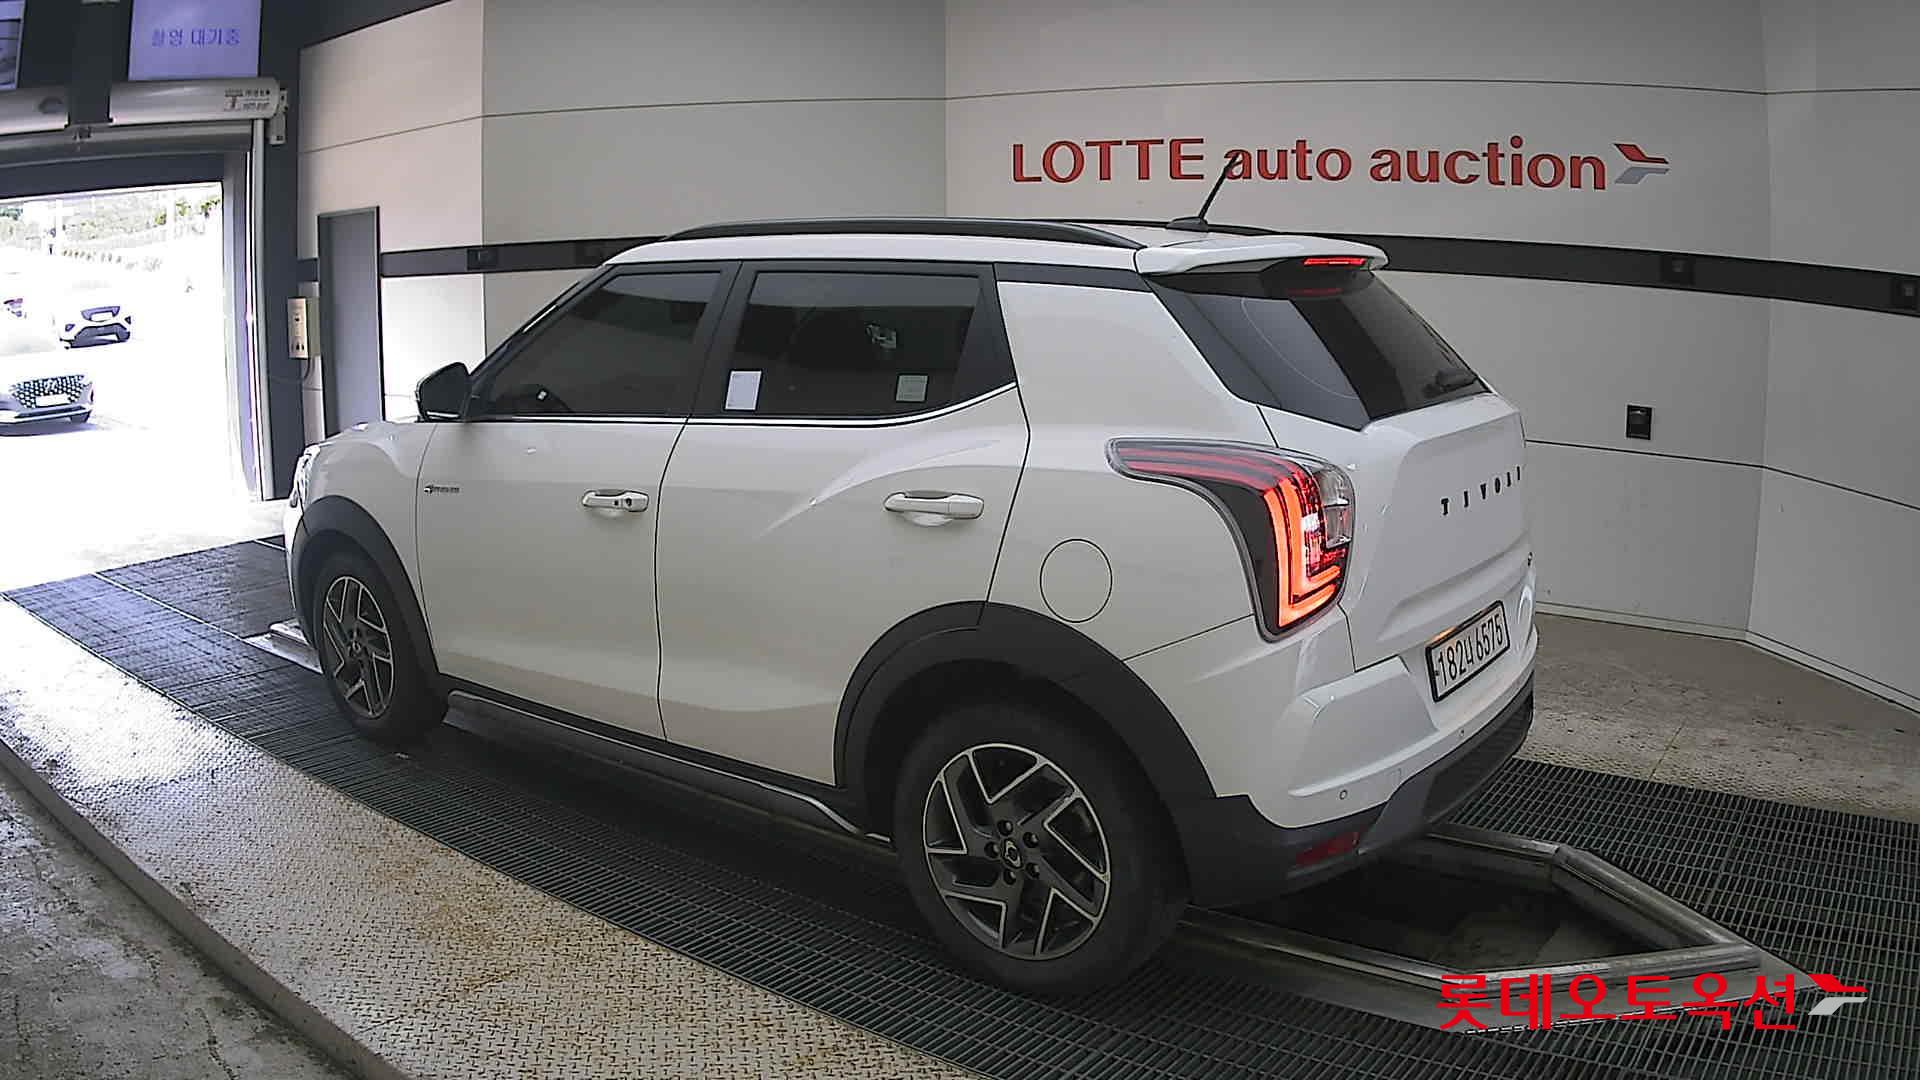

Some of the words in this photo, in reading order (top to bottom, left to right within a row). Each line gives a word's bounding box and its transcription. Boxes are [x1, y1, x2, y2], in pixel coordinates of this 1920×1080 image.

[1012, 138, 1205, 184] LOTTE
[1223, 139, 1353, 182] auto
[1369, 135, 1607, 191] auction
[1475, 614, 1504, 661] 6575
